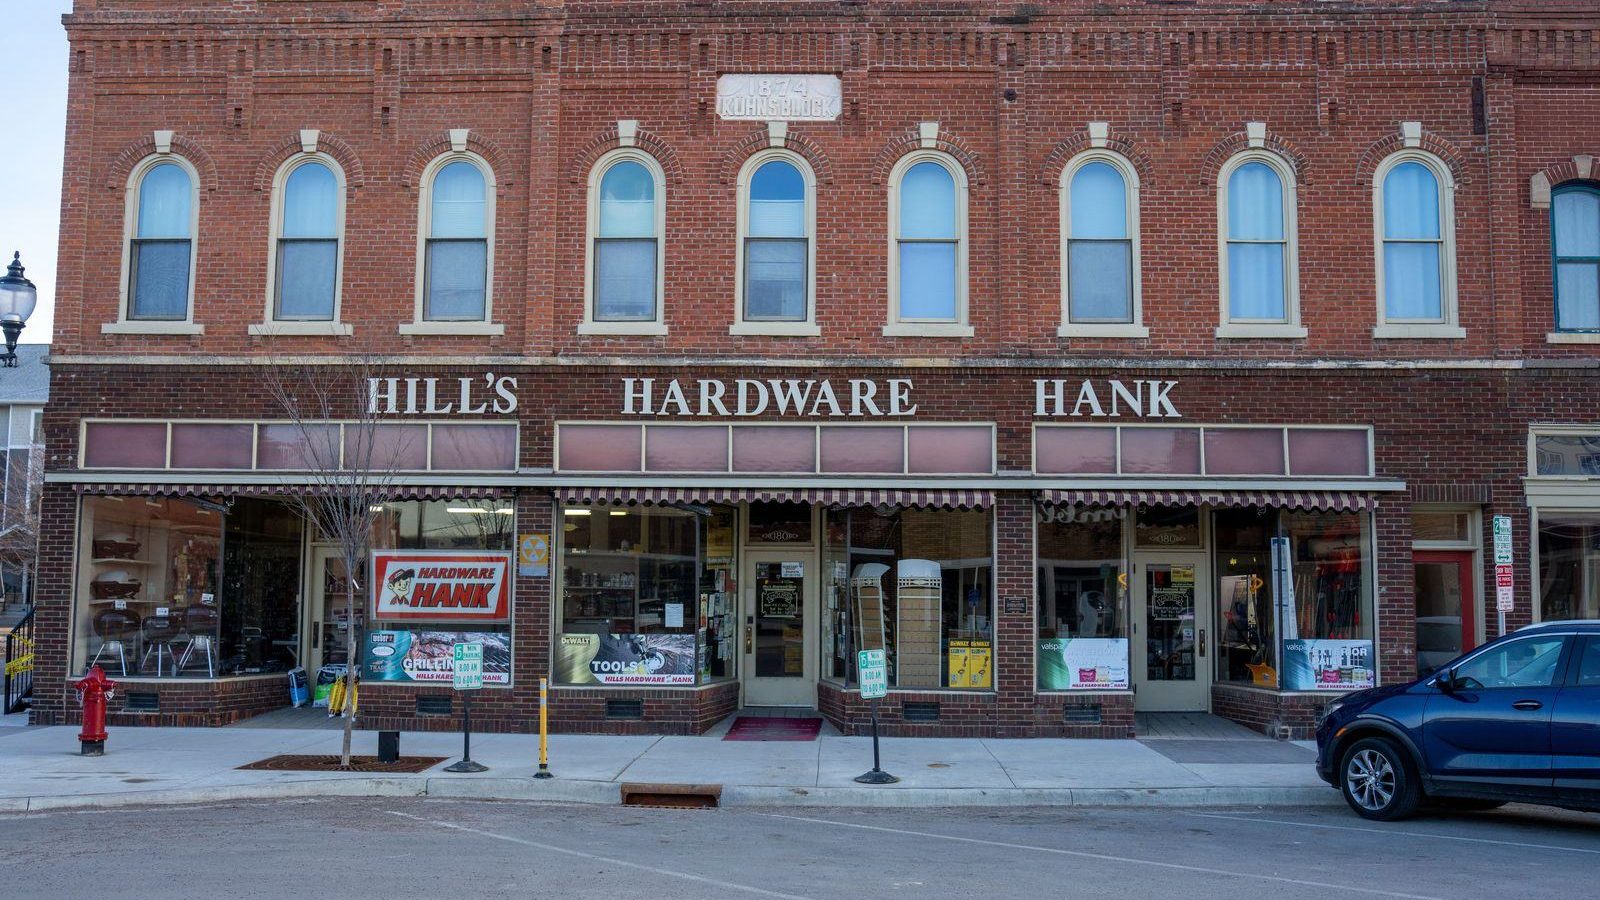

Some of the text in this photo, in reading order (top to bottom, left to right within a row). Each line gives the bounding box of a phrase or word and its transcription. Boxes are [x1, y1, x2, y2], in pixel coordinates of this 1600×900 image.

[749, 77, 807, 97] 1874
[781, 98, 834, 117] BLOCK
[366, 372, 1183, 417] HILL'S HARDWARE HANK
[418, 567, 496, 579] HARDWARE
[410, 583, 496, 608] HANK
[402, 658, 454, 670] GRILLIN
[471, 663, 478, 672] AM
[592, 660, 638, 672] TOOLS
[875, 671, 881, 679] AM
